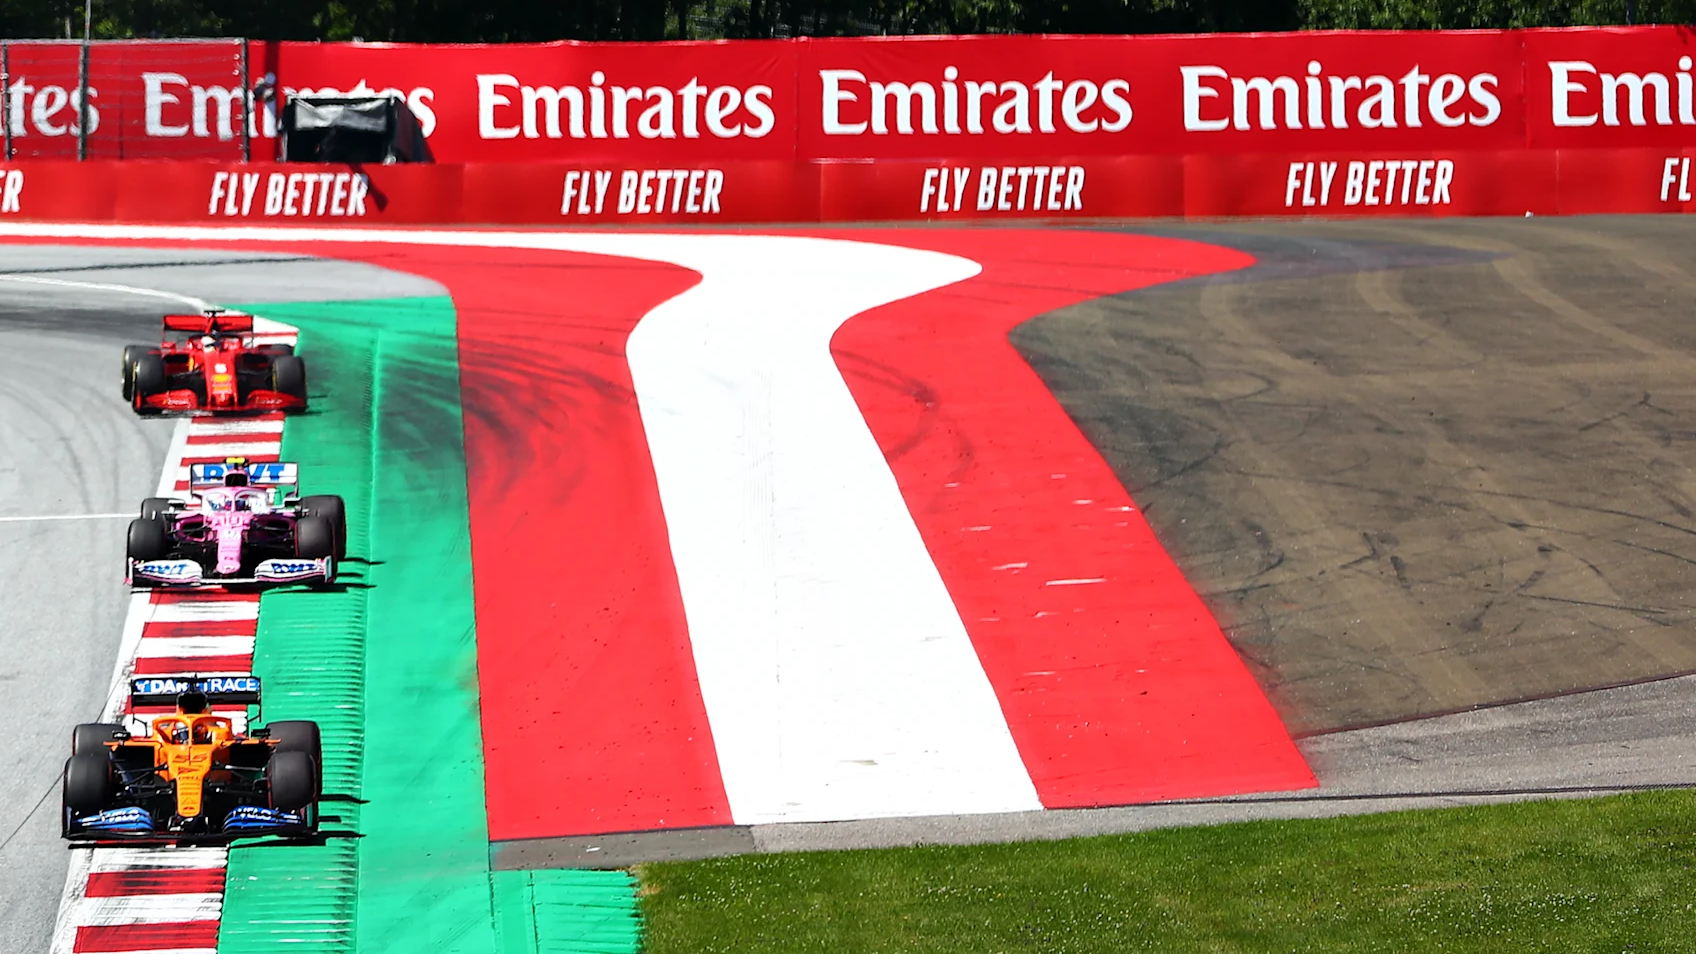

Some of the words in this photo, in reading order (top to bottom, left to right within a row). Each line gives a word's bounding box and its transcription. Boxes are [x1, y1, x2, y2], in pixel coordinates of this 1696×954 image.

[476, 70, 776, 140] Emirates
[819, 65, 1134, 135] Emirates
[1179, 60, 1502, 132] Emirates
[208, 171, 261, 218] FLY
[265, 172, 371, 218] BETTER
[560, 170, 613, 216] FLY
[617, 169, 725, 215] BETTER
[920, 167, 973, 214] FLY
[977, 165, 1086, 213] BETTER
[1285, 161, 1340, 208] FLY
[1344, 159, 1455, 207] BETTER
